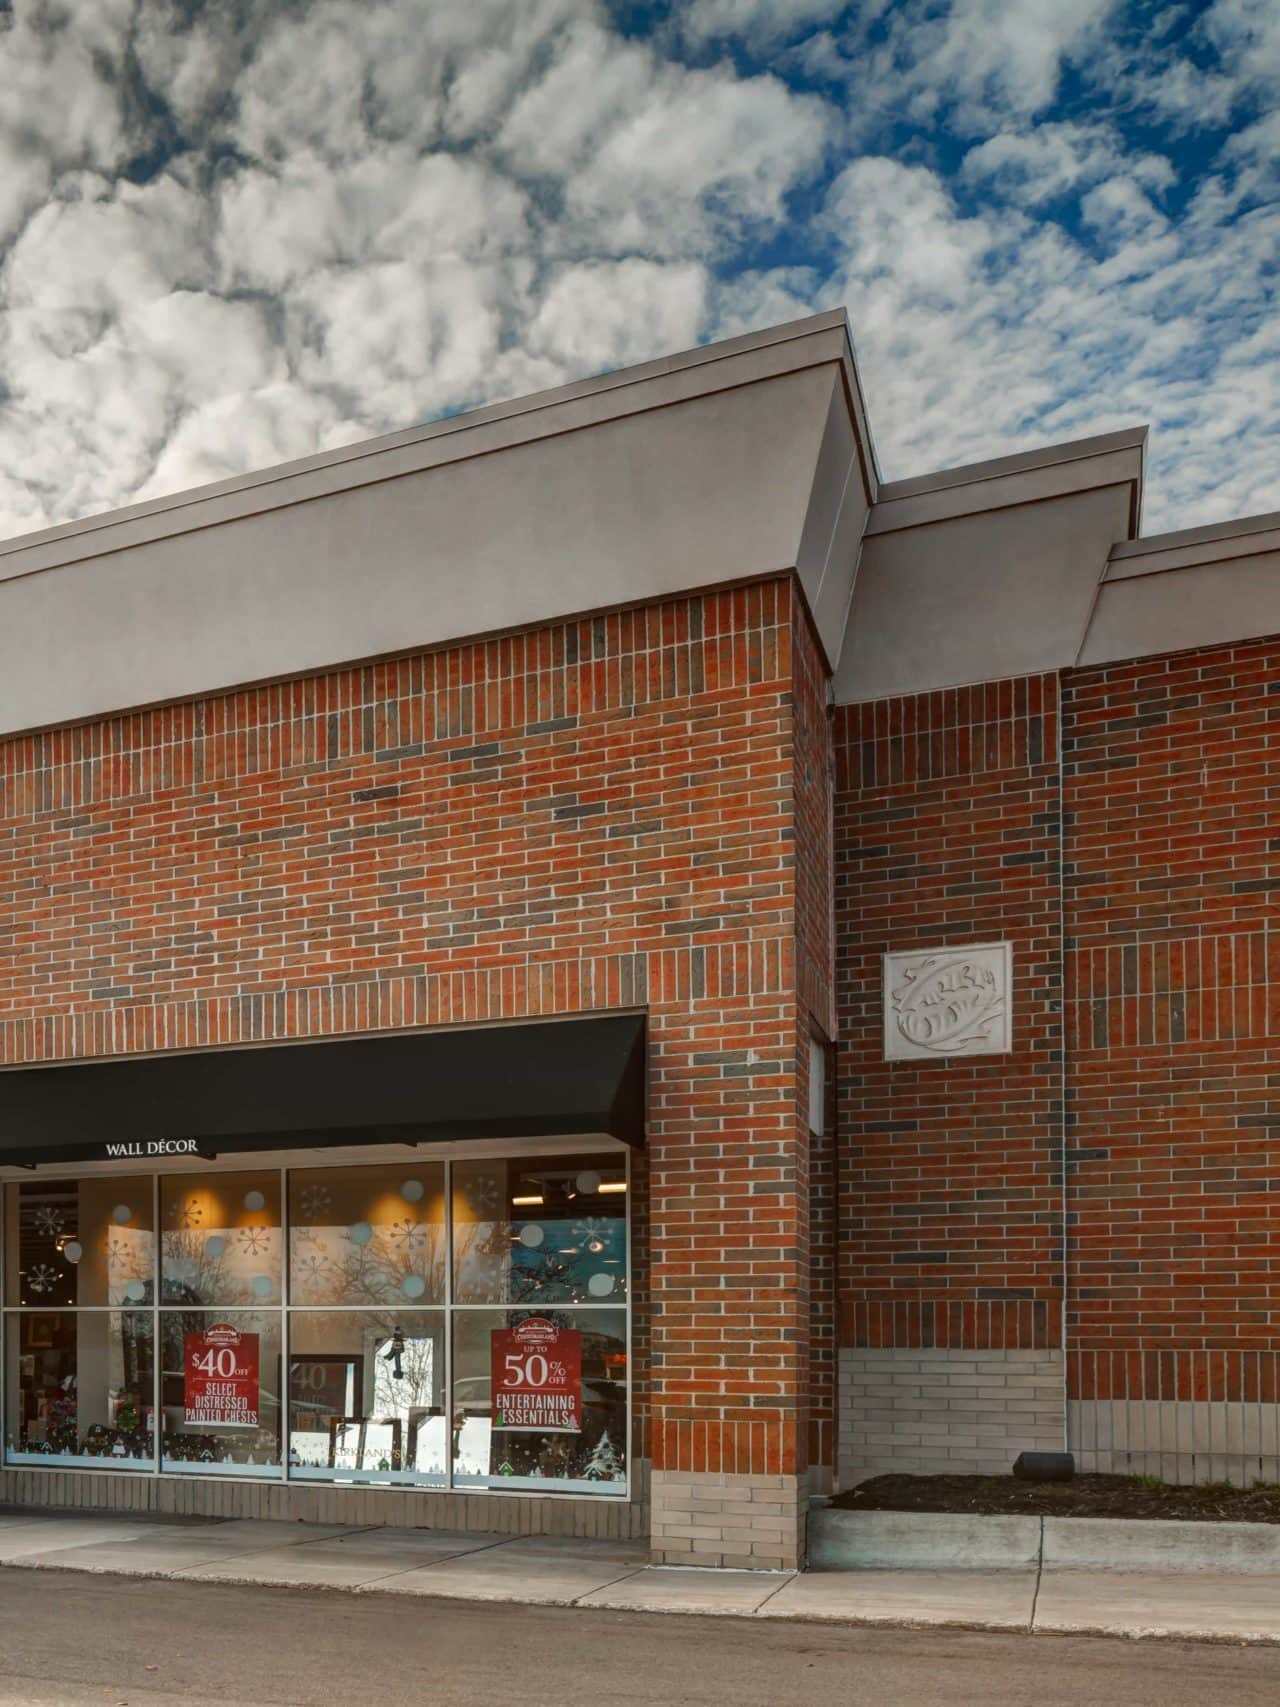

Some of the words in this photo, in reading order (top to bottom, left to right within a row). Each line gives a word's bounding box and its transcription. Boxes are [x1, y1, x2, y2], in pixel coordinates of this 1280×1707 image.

[106, 1142, 143, 1156] WALL
[147, 1138, 198, 1154] DÉCOR
[192, 1348, 237, 1378] $40
[234, 1368, 249, 1376] OFF
[548, 1376, 567, 1385] OFF
[206, 1383, 237, 1396] SELECT
[195, 1395, 248, 1410] DISTRESSED
[496, 1393, 575, 1410] ENTERTAINING
[185, 1408, 222, 1422] PAINTED
[224, 1409, 258, 1424] CHESTS
[503, 1409, 569, 1425] ESSENTIALS
